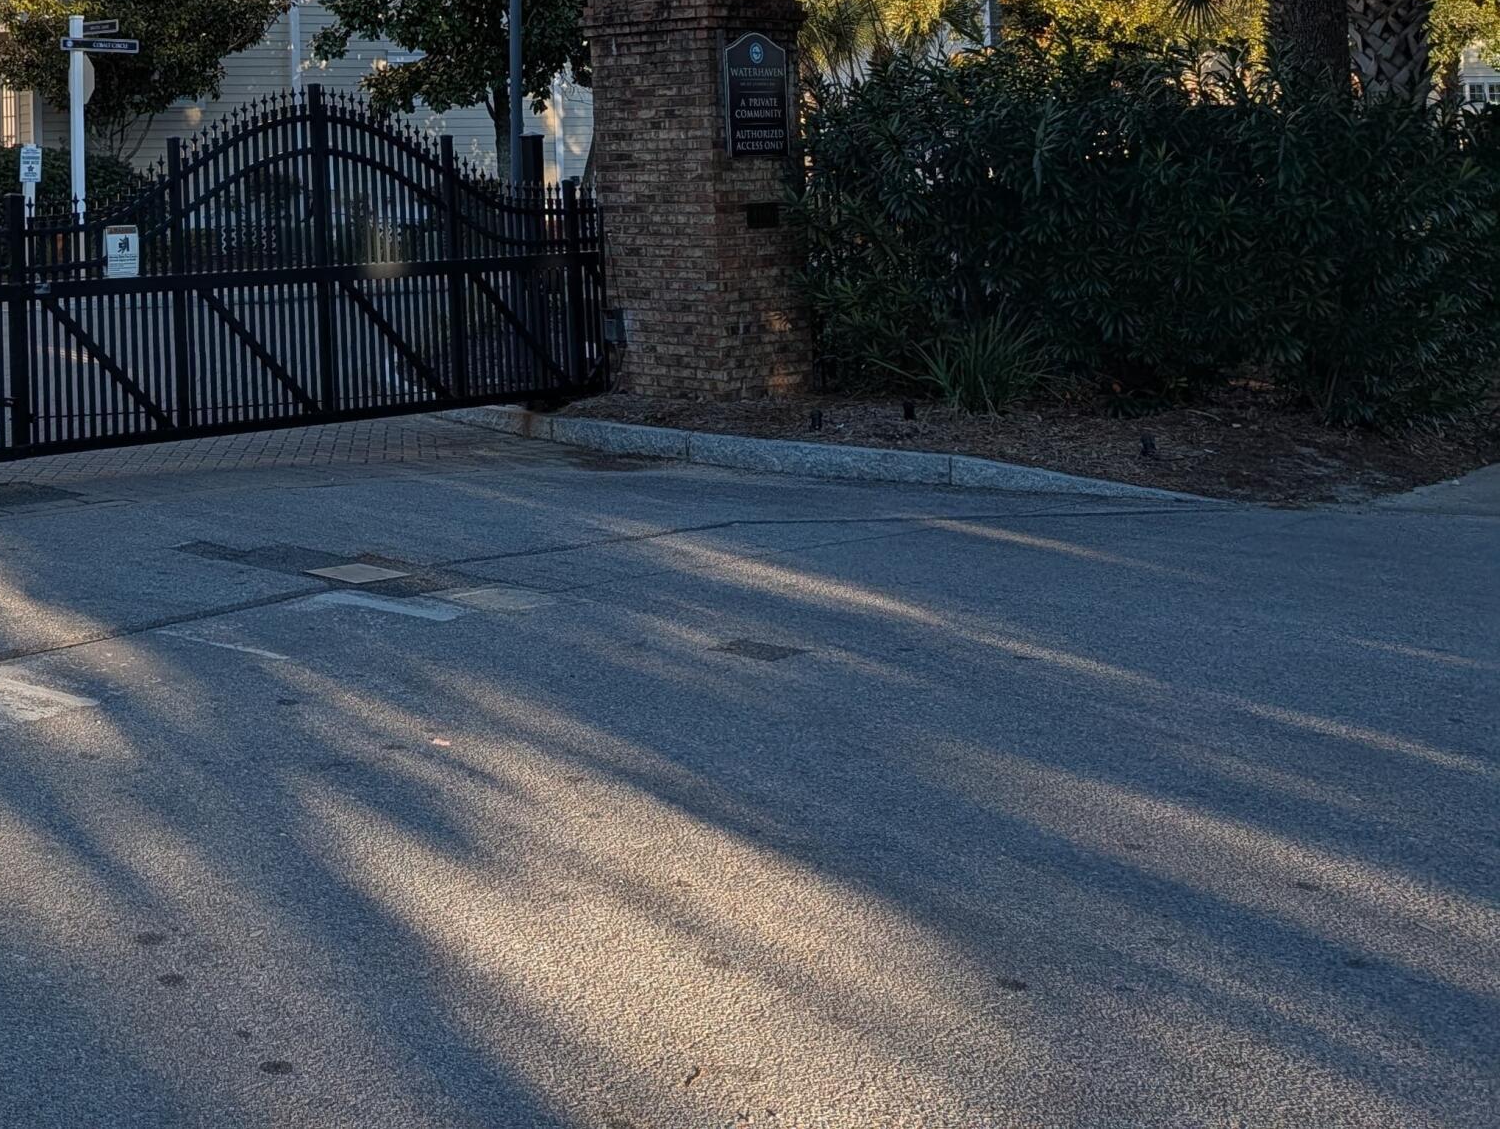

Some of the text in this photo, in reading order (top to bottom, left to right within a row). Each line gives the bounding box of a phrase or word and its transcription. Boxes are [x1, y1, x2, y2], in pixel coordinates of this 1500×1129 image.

[730, 67, 784, 77] WATERHAVEN
[740, 97, 778, 107] A PRIVATE
[735, 109, 782, 119] COMMUNITY
[736, 129, 784, 139] AUTHORIZED
[736, 140, 784, 151] ACCESS ONLY
